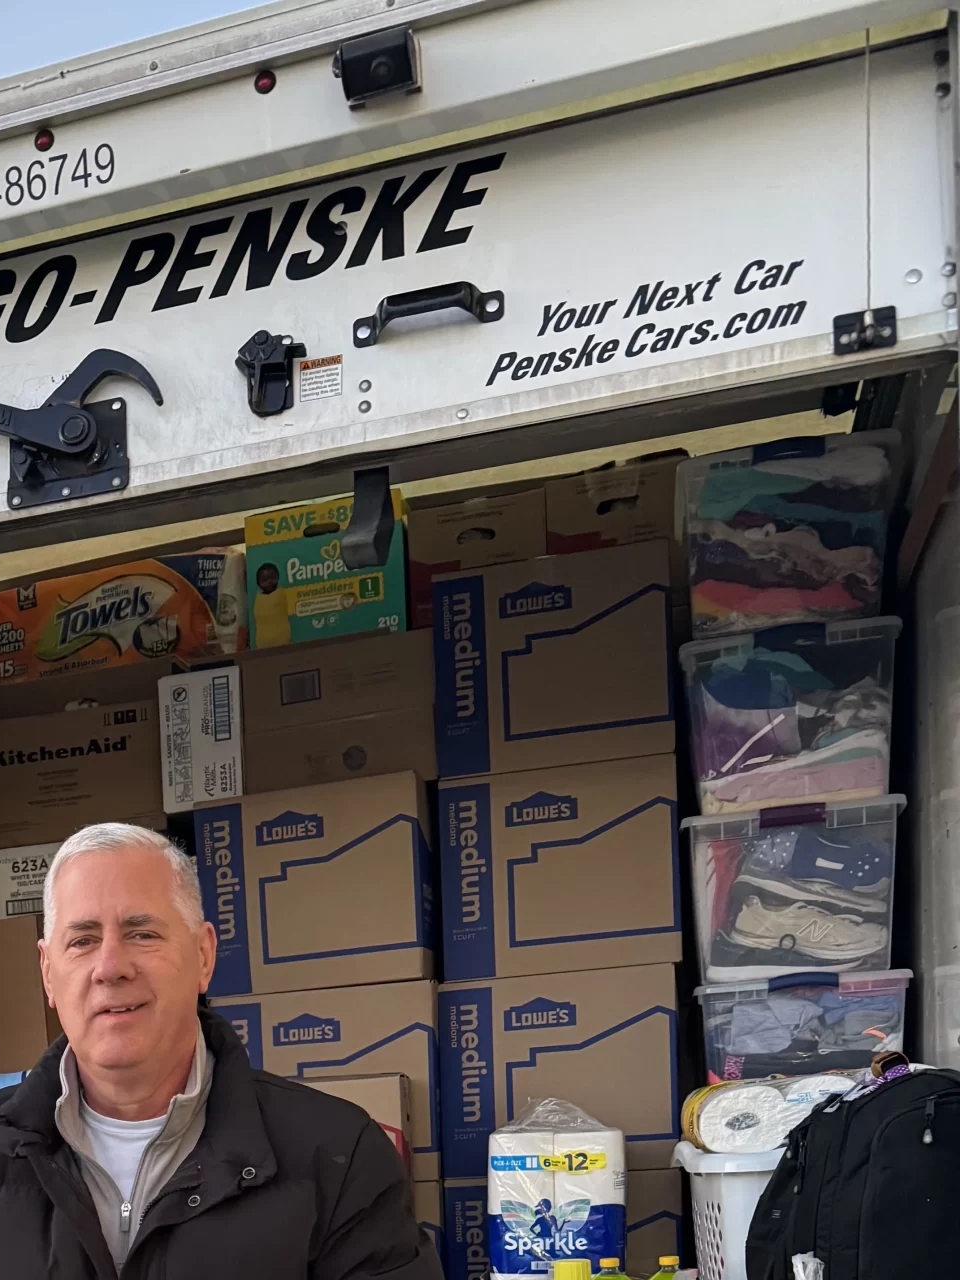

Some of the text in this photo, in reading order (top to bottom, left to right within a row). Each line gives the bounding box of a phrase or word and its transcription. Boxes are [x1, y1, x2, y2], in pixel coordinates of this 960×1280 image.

[537, 258, 805, 337] Your Next Car
[311, 355, 340, 369] WARNING
[263, 510, 317, 536] SAVE
[198, 559, 223, 570] THICK
[286, 557, 359, 583] Pampe
[506, 591, 565, 615] LOWE'S
[55, 586, 153, 648] Towels
[377, 614, 399, 628] 210
[452, 592, 481, 718] medium
[219, 763, 228, 793] 8253A
[511, 800, 571, 823] LOWE'S
[262, 819, 317, 842] LOWE'S
[448, 803, 458, 847] mediana
[203, 823, 212, 866] mediana
[11, 858, 48, 874] 623A
[459, 800, 487, 922] medium
[213, 819, 241, 941] medium
[450, 1006, 459, 1048] mediana
[511, 1008, 570, 1029] LOWE'S
[279, 1024, 334, 1043] LOWE'S
[460, 1004, 487, 1122] medium
[543, 1158, 551, 1167] 6
[564, 1152, 589, 1172] 12
[504, 1231, 588, 1255] Sparkle
